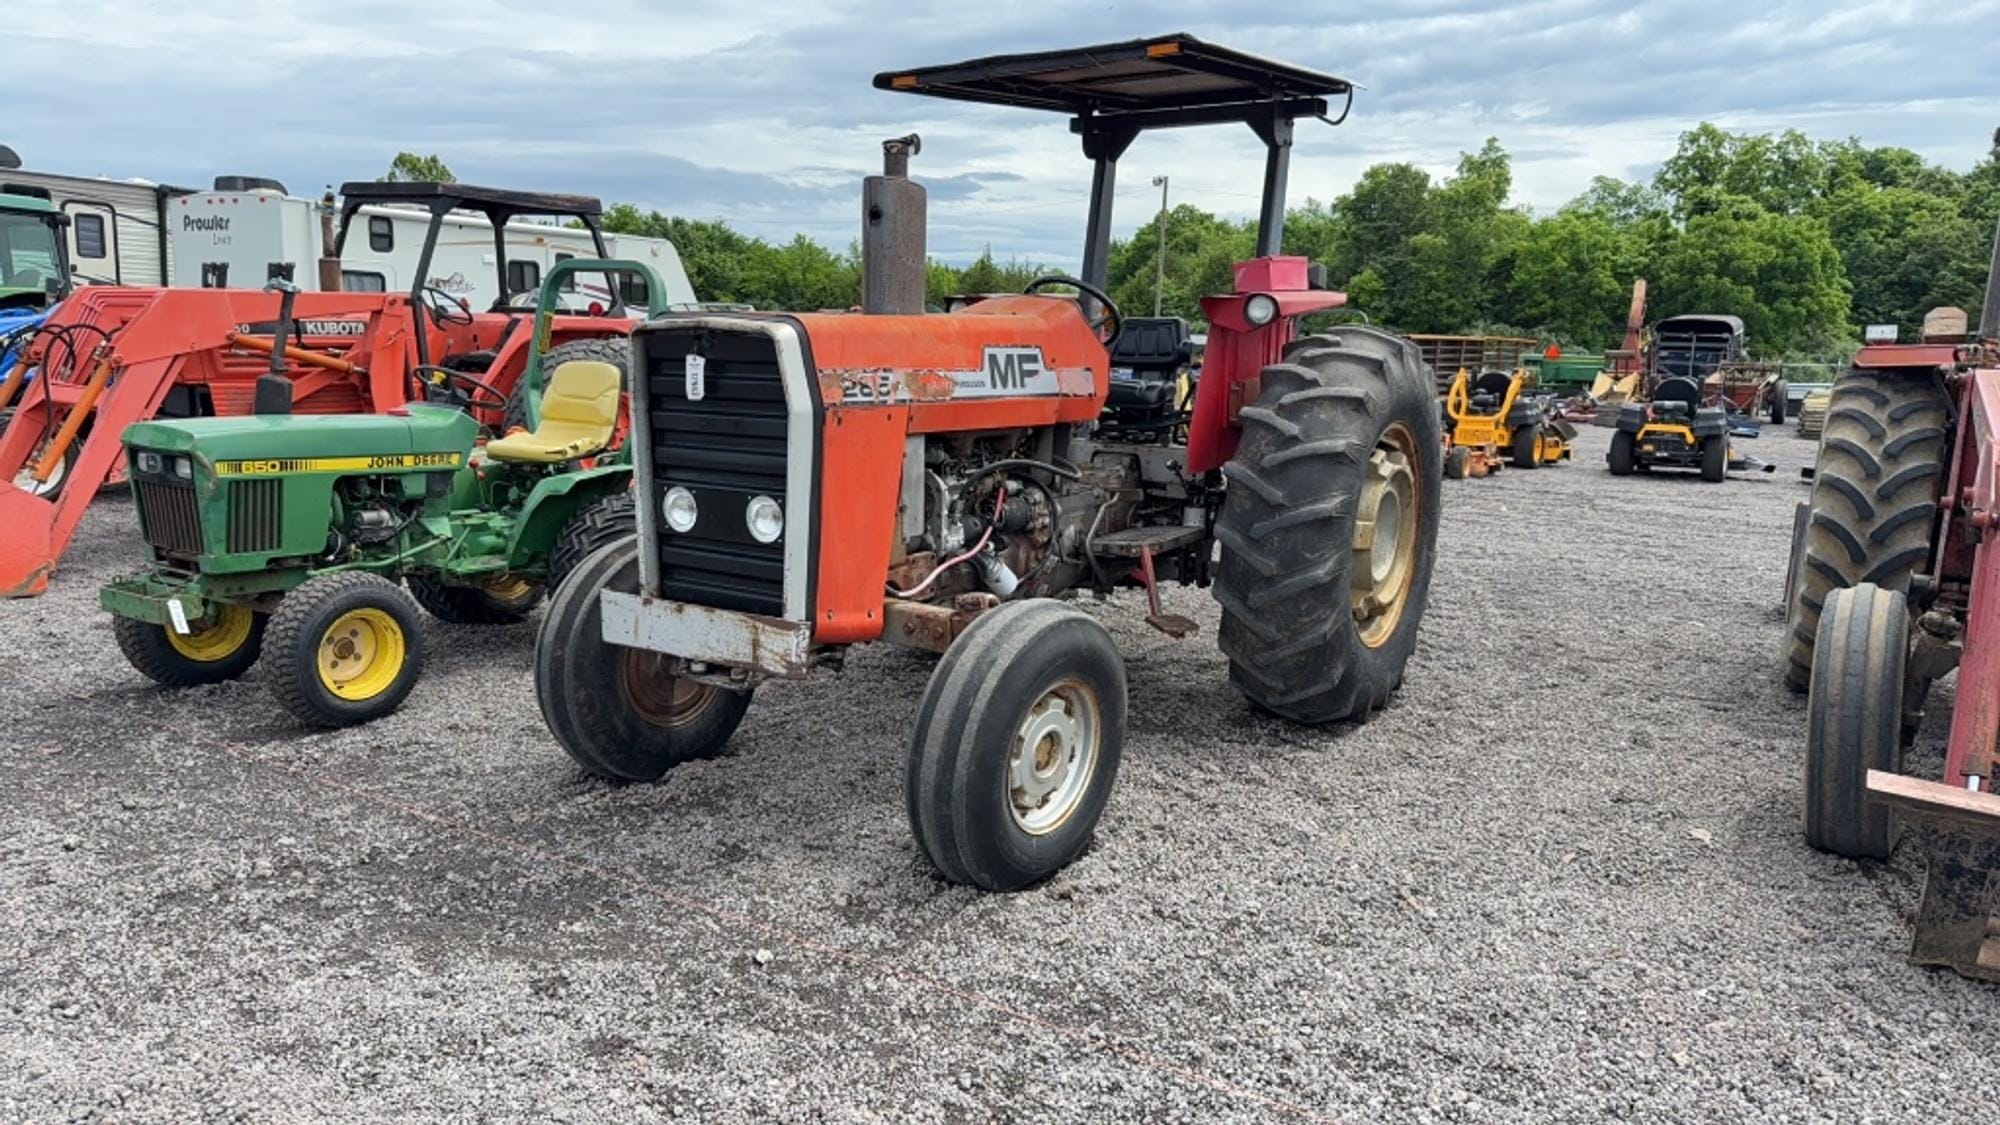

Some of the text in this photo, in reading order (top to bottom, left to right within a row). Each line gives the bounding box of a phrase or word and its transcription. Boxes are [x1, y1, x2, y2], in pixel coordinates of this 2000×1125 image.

[183, 214, 230, 231] Prowler
[306, 321, 365, 335] KUBOTA
[987, 353, 1040, 389] MF
[242, 453, 453, 474] 650 JOHN DEERE
